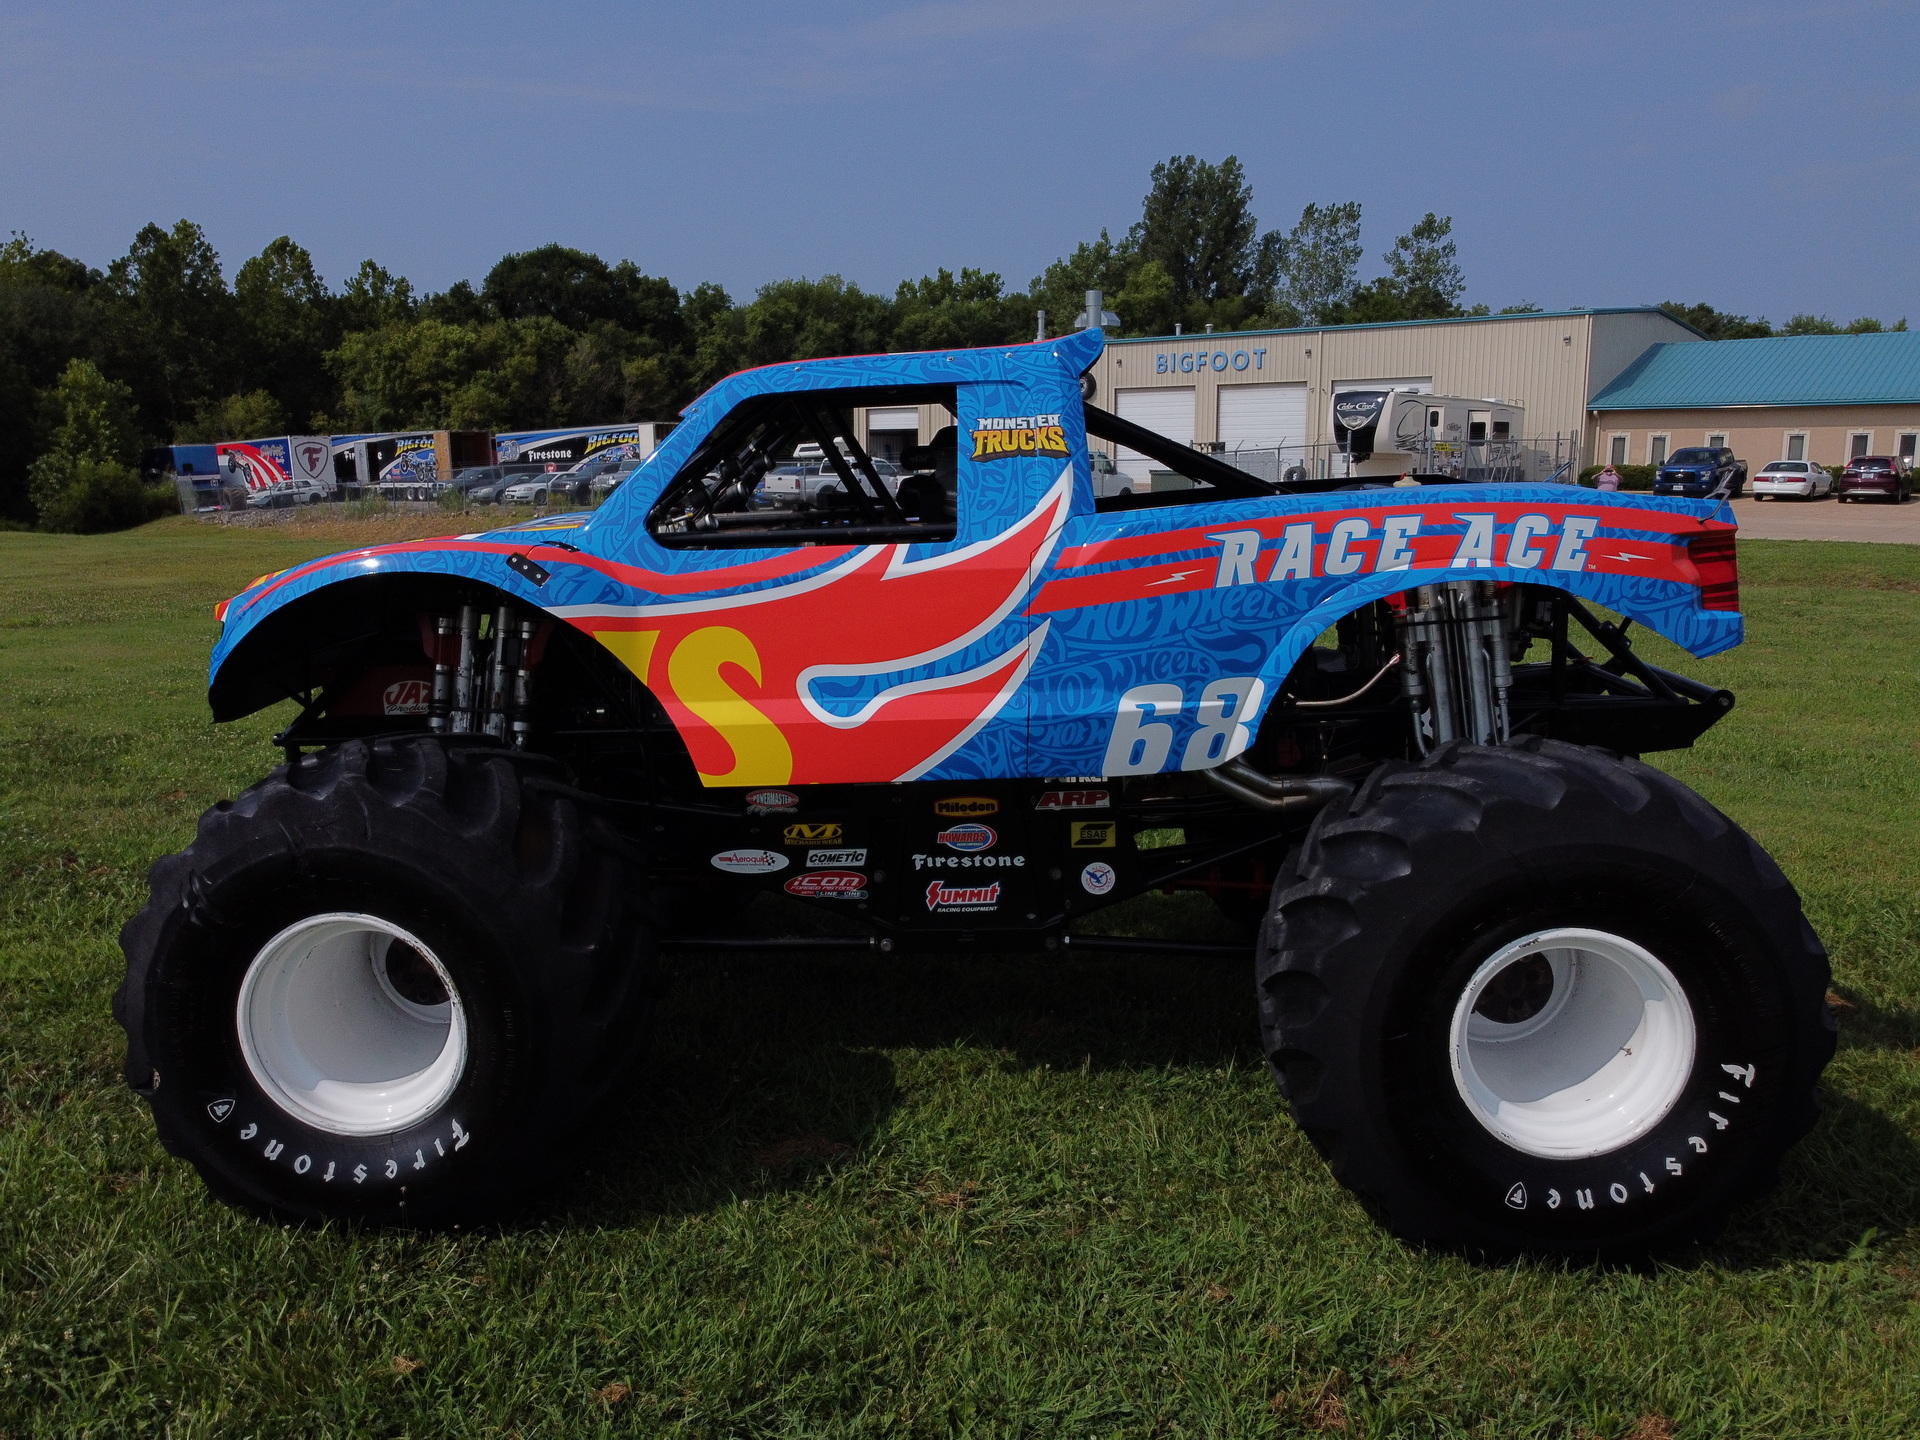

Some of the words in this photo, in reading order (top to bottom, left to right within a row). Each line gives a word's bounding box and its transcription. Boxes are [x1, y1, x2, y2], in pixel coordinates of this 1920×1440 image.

[1156, 348, 1266, 374] BIGFOOT
[977, 413, 1061, 430] MONSTER
[395, 438, 434, 457] BIGFOO
[585, 431, 639, 455] BIGFOO
[971, 426, 1070, 460] TRUCKS
[527, 449, 572, 462] Firestone
[1204, 515, 1424, 588] RACE
[1450, 512, 1600, 572] ACE
[1102, 676, 1265, 777] 68
[937, 801, 996, 813] Milodon
[1037, 790, 1109, 807] ARP
[784, 838, 821, 846] MECHANIX
[938, 831, 986, 843] HOWARDS
[1080, 830, 1107, 838] ESAB
[731, 852, 769, 864] Aeroquip
[809, 850, 865, 863] COMETIC
[911, 853, 1026, 871] Firestone
[926, 880, 1000, 911] SUMMIT
[1547, 1063, 1756, 1210] Firestone
[240, 1118, 470, 1184] Firestone
